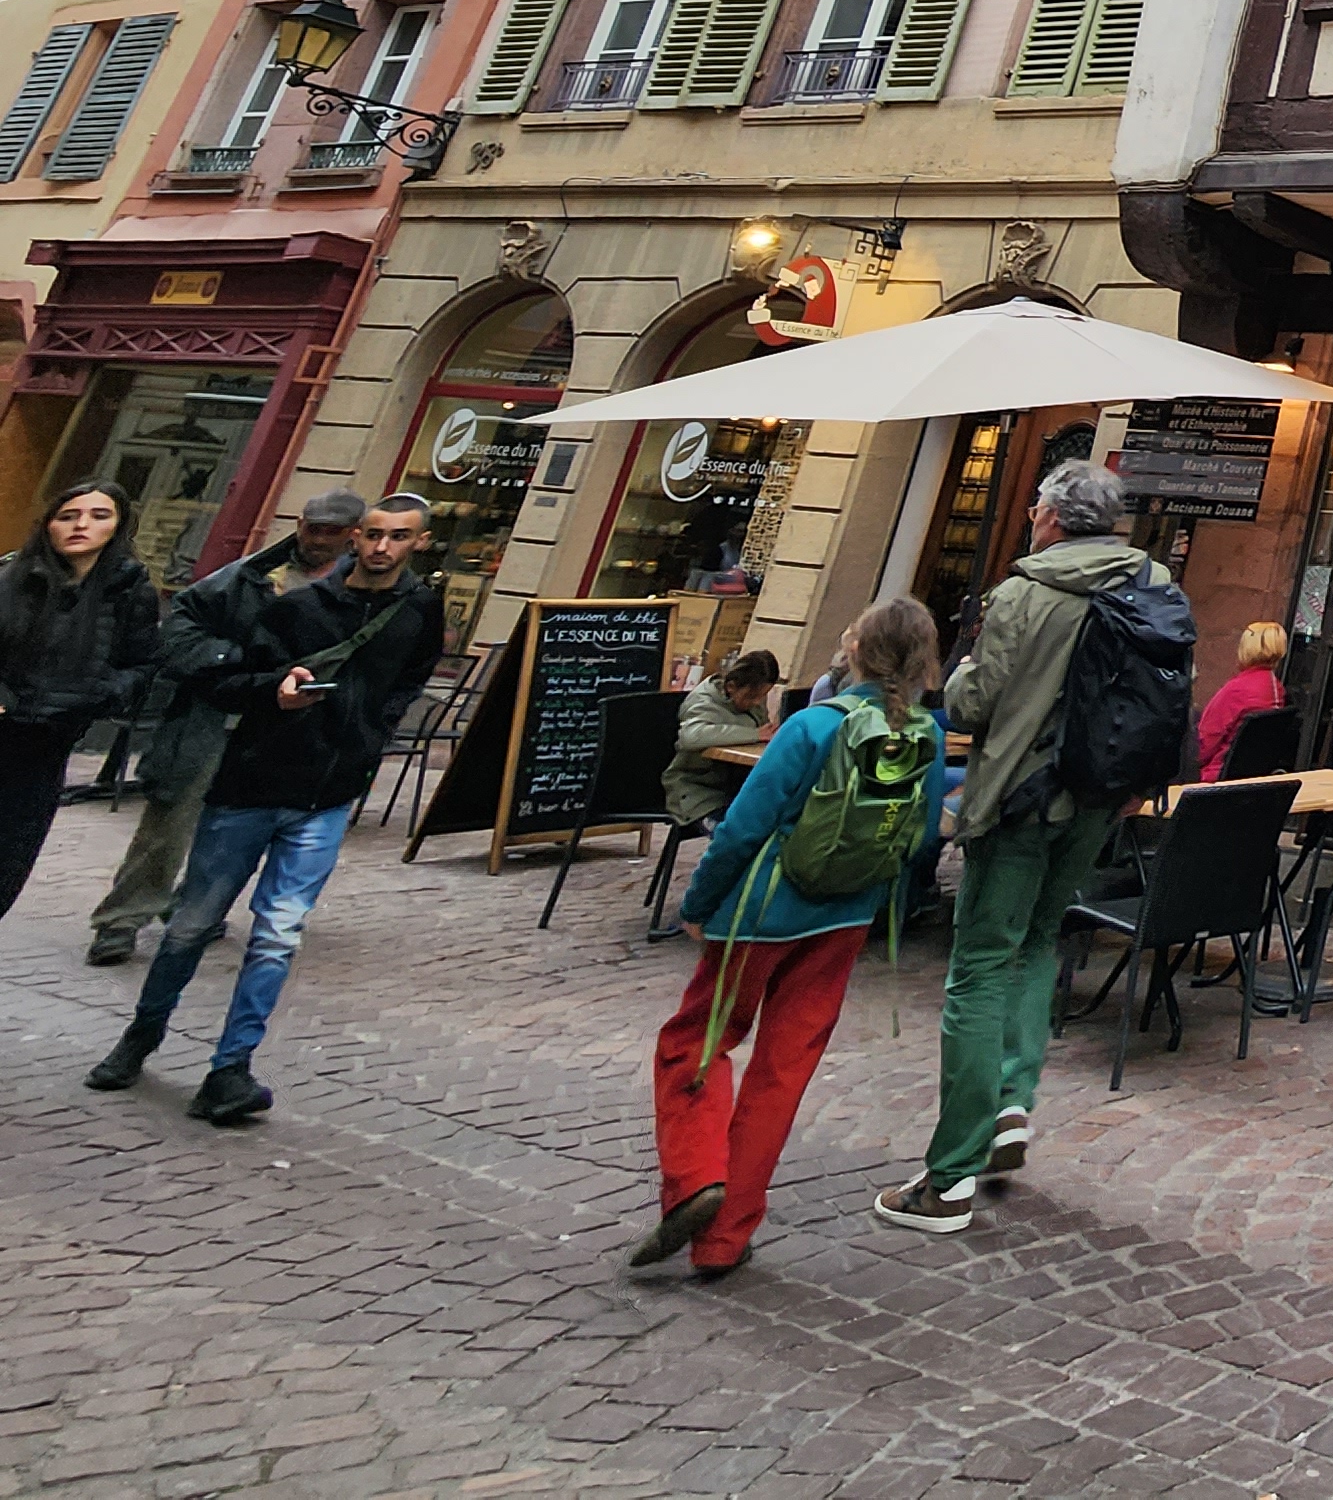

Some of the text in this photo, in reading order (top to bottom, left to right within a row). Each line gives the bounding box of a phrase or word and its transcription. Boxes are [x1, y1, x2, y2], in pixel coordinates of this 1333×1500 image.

[1171, 404, 1201, 416] Musée
[1203, 406, 1248, 418] d'Histoire
[1168, 418, 1248, 433] et d'Ethnographie
[511, 442, 527, 458] du
[528, 444, 543, 458] Th
[1162, 437, 1184, 449] Quai
[1211, 439, 1269, 453] Poissonnerie
[748, 459, 765, 476] du
[1182, 459, 1264, 475] Marché Couvert
[1158, 479, 1196, 492] Quartier
[1200, 482, 1213, 493] des
[1216, 482, 1259, 496] Tanneurs
[1165, 501, 1255, 517] Ancienne Douane
[548, 611, 661, 624] maison de thé
[544, 629, 619, 643] L'ESSENCE
[622, 630, 636, 642] DU
[640, 627, 660, 642] THÉ
